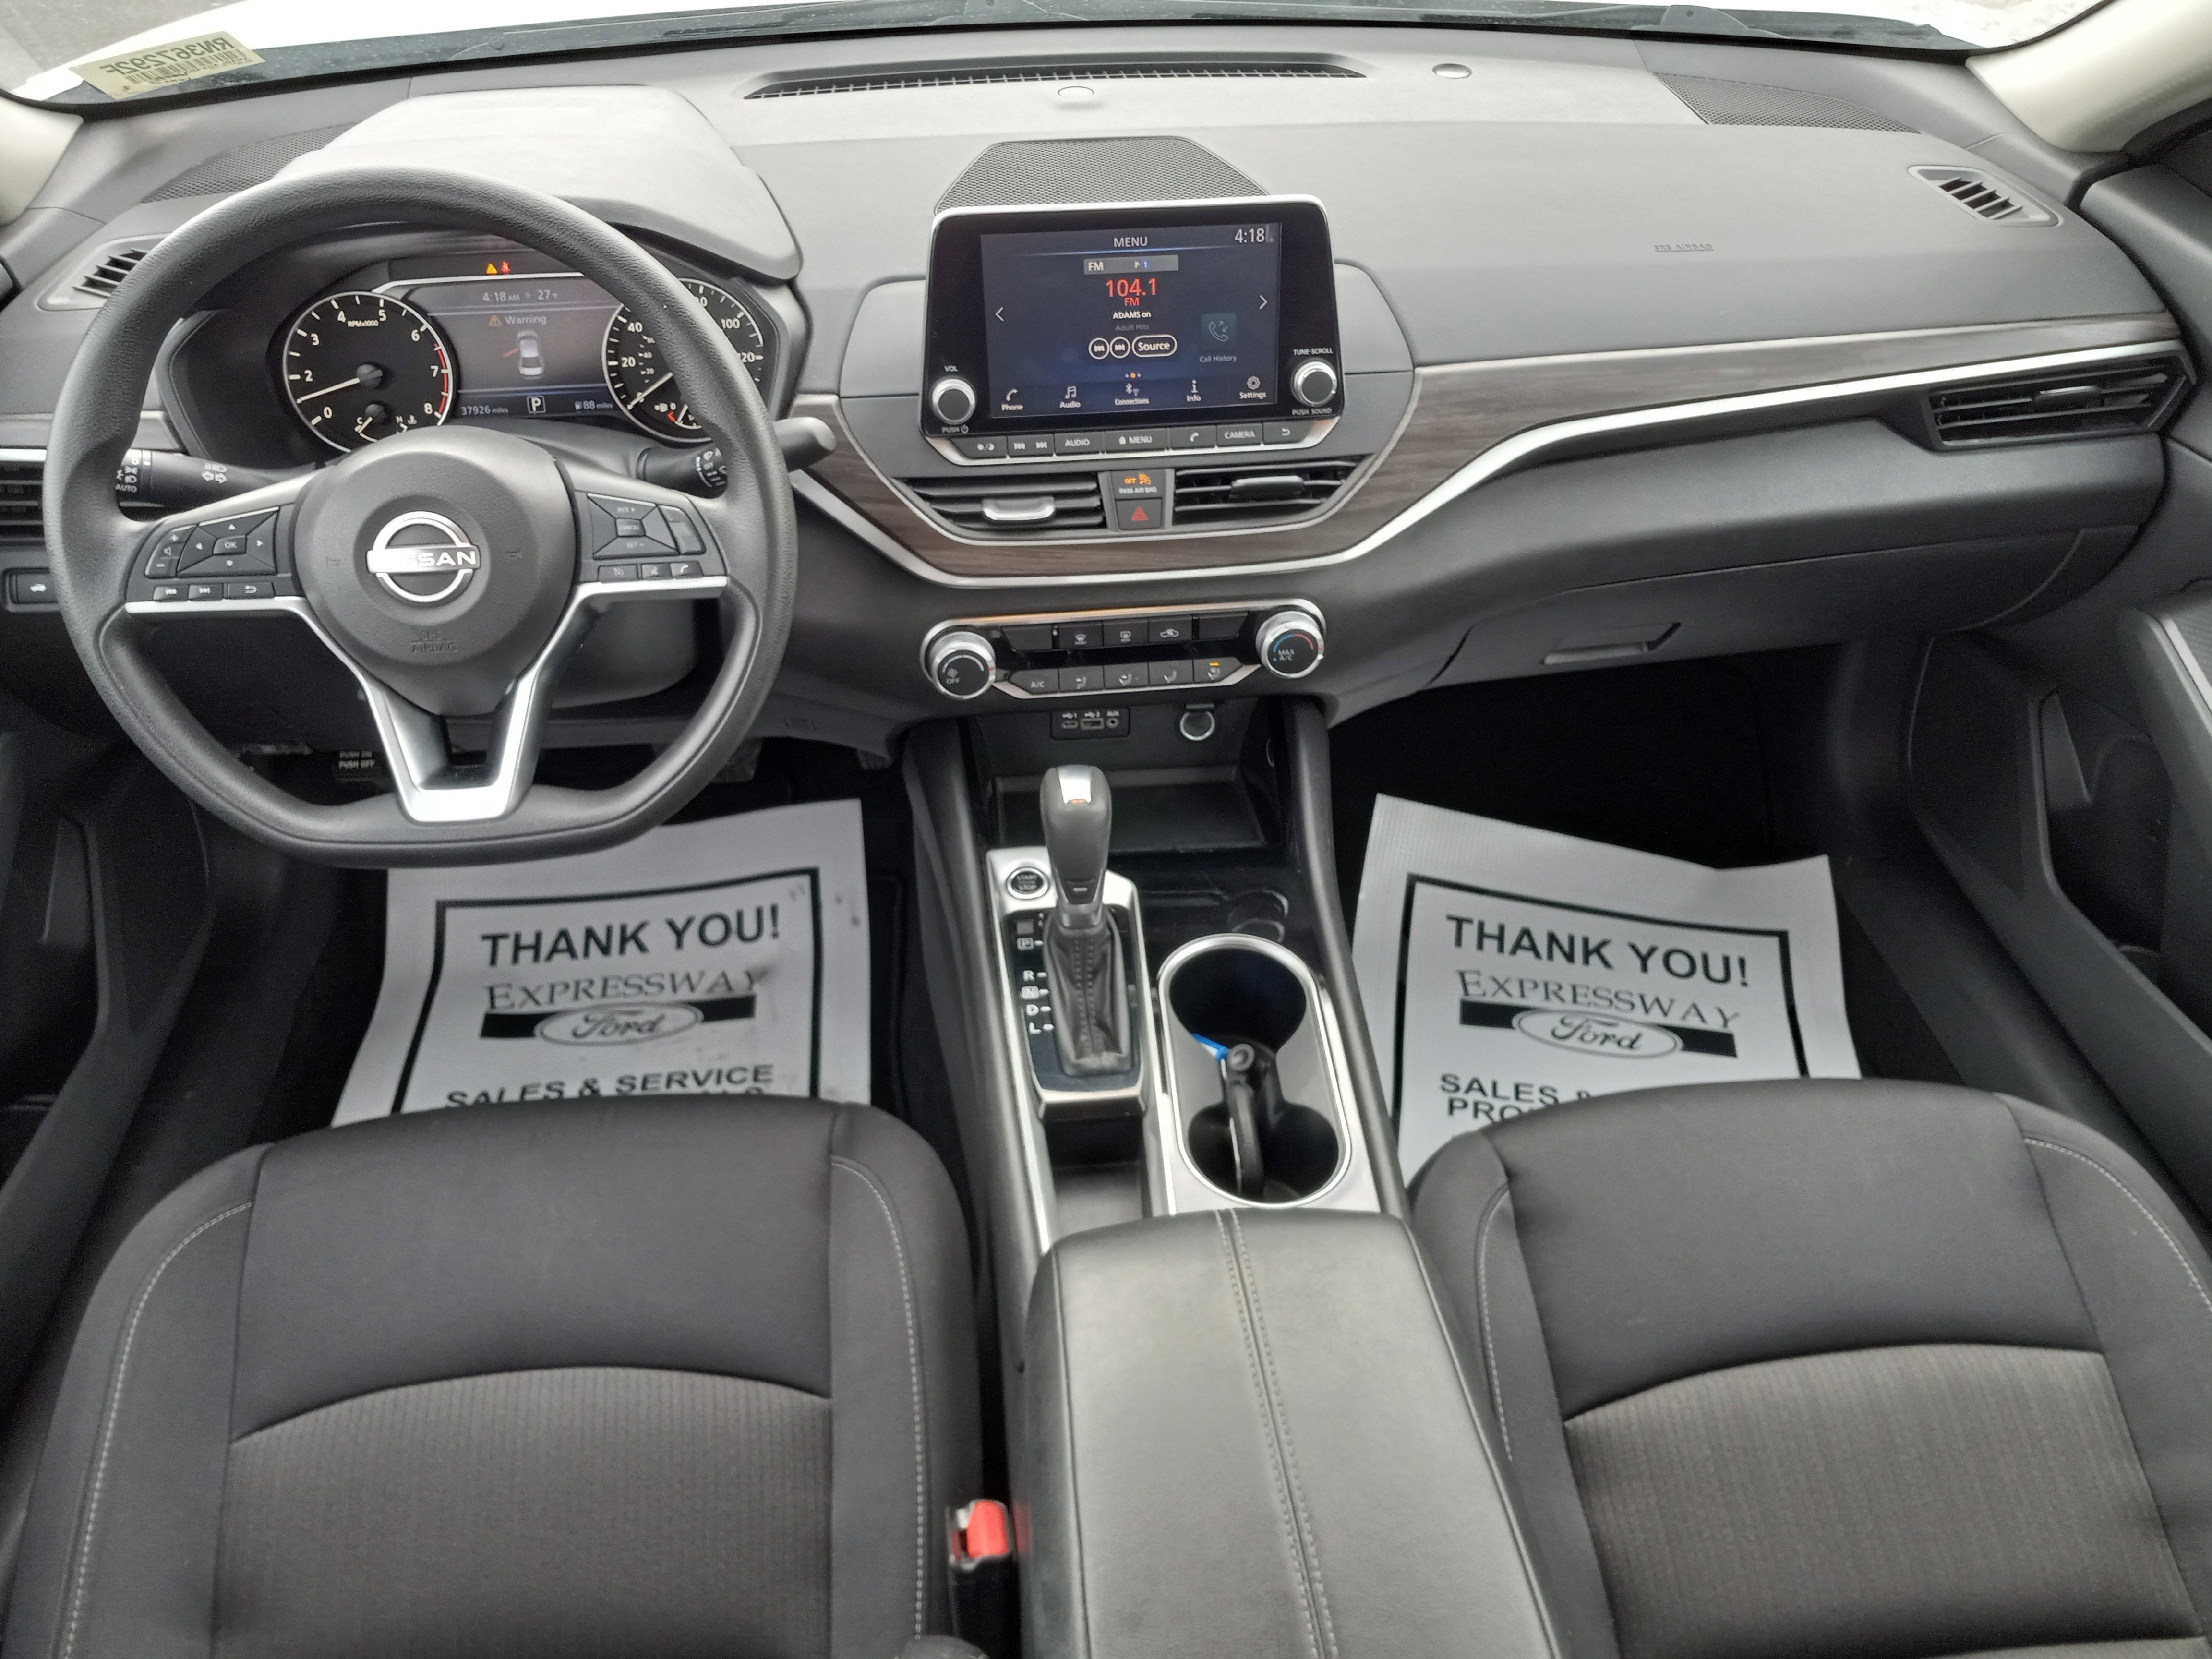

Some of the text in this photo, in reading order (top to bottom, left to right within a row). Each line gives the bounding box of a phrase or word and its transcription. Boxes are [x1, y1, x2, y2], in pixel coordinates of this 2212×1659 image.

[1234, 228, 1265, 243] 4:18
[1114, 237, 1148, 247] MENU
[1088, 262, 1104, 272] FM
[1106, 278, 1157, 297] 104.1
[696, 297, 708, 307] 0
[1124, 297, 1140, 306] FM
[337, 311, 346, 322] 4
[378, 310, 386, 321] 5
[505, 315, 547, 325] Warning
[627, 322, 643, 333] 40
[721, 318, 740, 329] 100
[311, 333, 320, 345] 3
[411, 329, 420, 341] 6
[1138, 341, 1170, 351] Source
[621, 356, 636, 368] 20
[1213, 355, 1238, 363] History
[304, 370, 313, 382] 2
[430, 365, 438, 377] 7
[1187, 394, 1202, 402] Info
[1239, 390, 1267, 400] Settings
[583, 399, 595, 409] 88
[1114, 397, 1150, 406] Connections
[324, 406, 333, 419] 0
[424, 402, 433, 415] 8
[461, 405, 491, 416] 37926
[1129, 435, 1153, 445] MENU
[1224, 430, 1256, 440] CAMERA
[1065, 438, 1091, 448] AUDIO
[115, 483, 138, 493] AUTO
[224, 541, 237, 549] OK
[481, 903, 779, 967] THANK YOU!
[1446, 914, 1748, 988] THANK YOU!
[1022, 970, 1035, 981] R
[1455, 969, 1742, 1029] EXPRESSWAY
[1026, 1004, 1039, 1016] D
[572, 1010, 667, 1040] Ford
[1029, 1022, 1042, 1034] L
[1551, 1013, 1644, 1051] Ford
[615, 1064, 774, 1095] SERVICE
[1440, 1073, 1560, 1104] SALES
